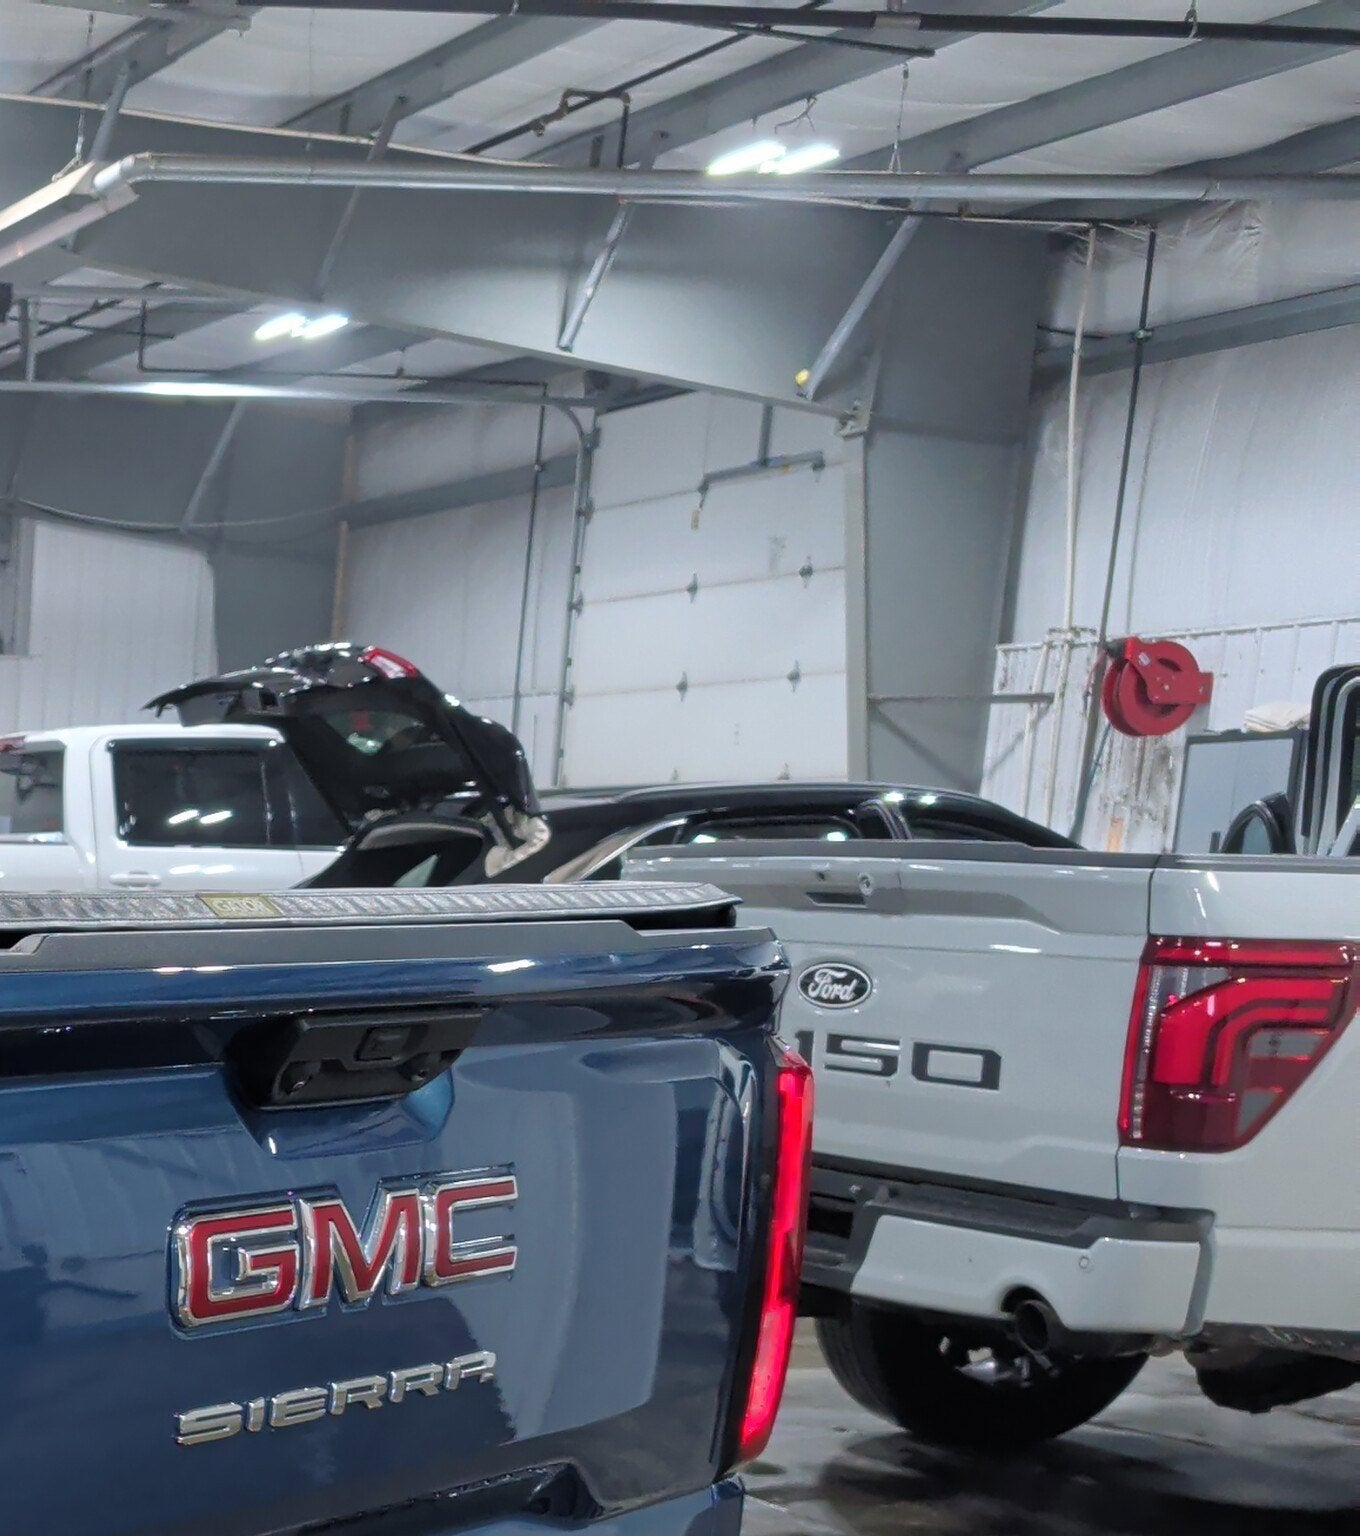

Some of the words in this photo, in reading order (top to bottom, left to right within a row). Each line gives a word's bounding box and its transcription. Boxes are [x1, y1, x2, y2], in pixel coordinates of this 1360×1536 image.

[807, 968, 857, 1001] Ford
[173, 1175, 518, 1328] GMC
[176, 1350, 497, 1446] SIERRA
